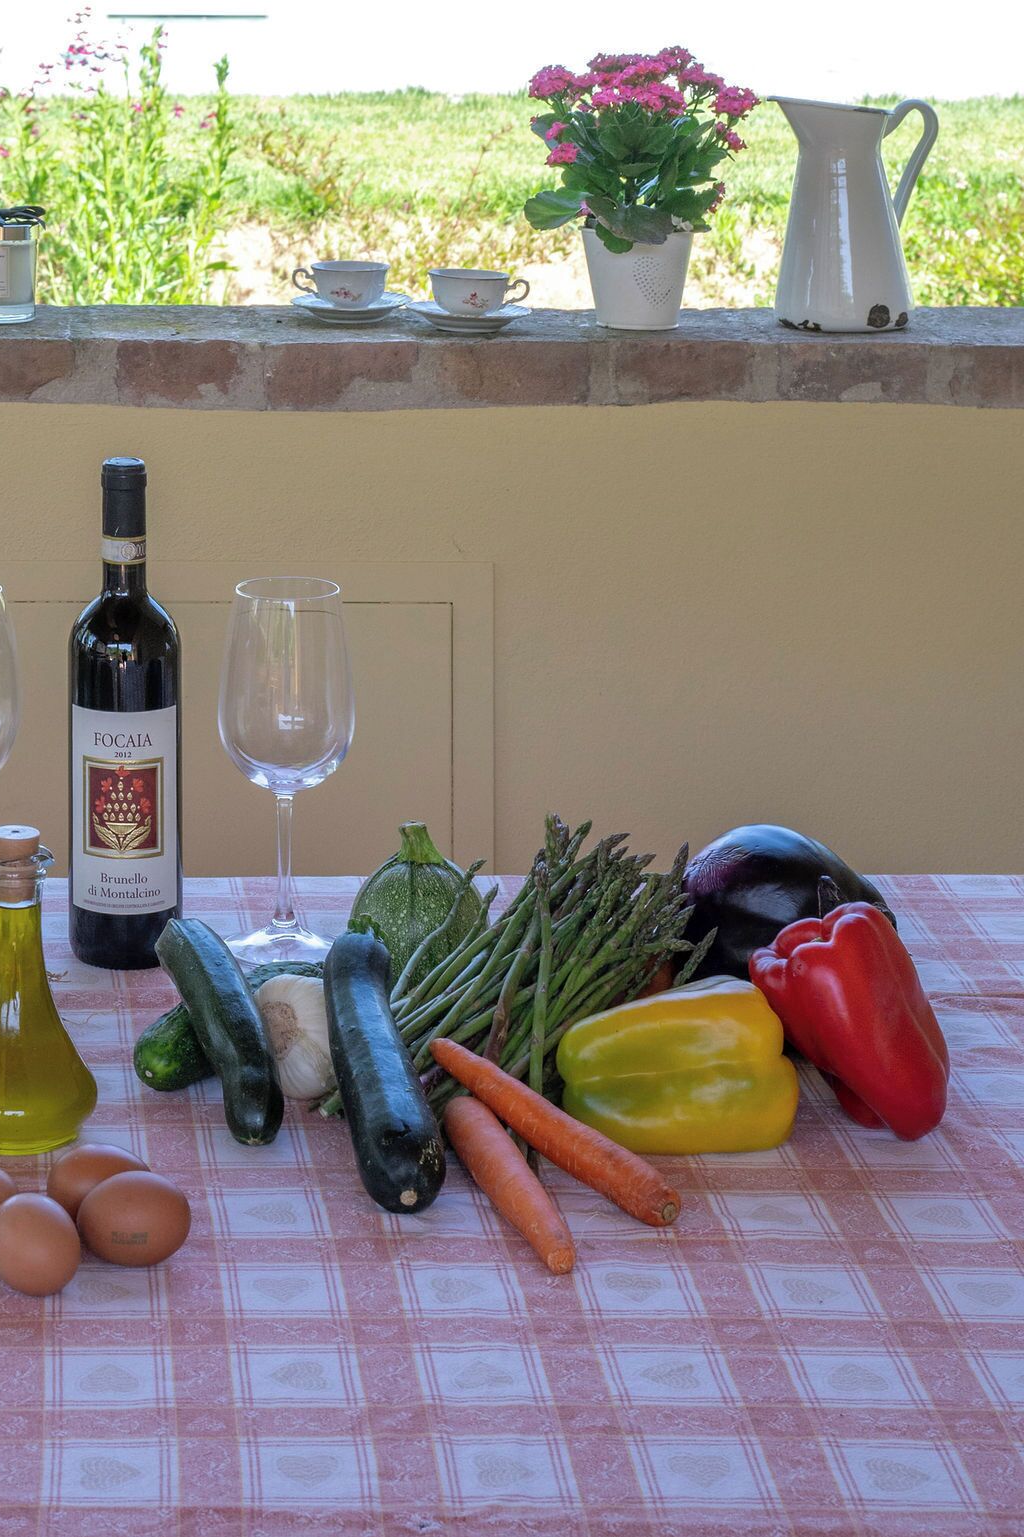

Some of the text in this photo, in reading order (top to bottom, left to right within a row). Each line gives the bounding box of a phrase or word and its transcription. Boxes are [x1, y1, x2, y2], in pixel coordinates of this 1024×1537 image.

[94, 732, 152, 748] FOCAIA
[100, 872, 148, 885] Brunello
[87, 884, 161, 899] di Montalcino
